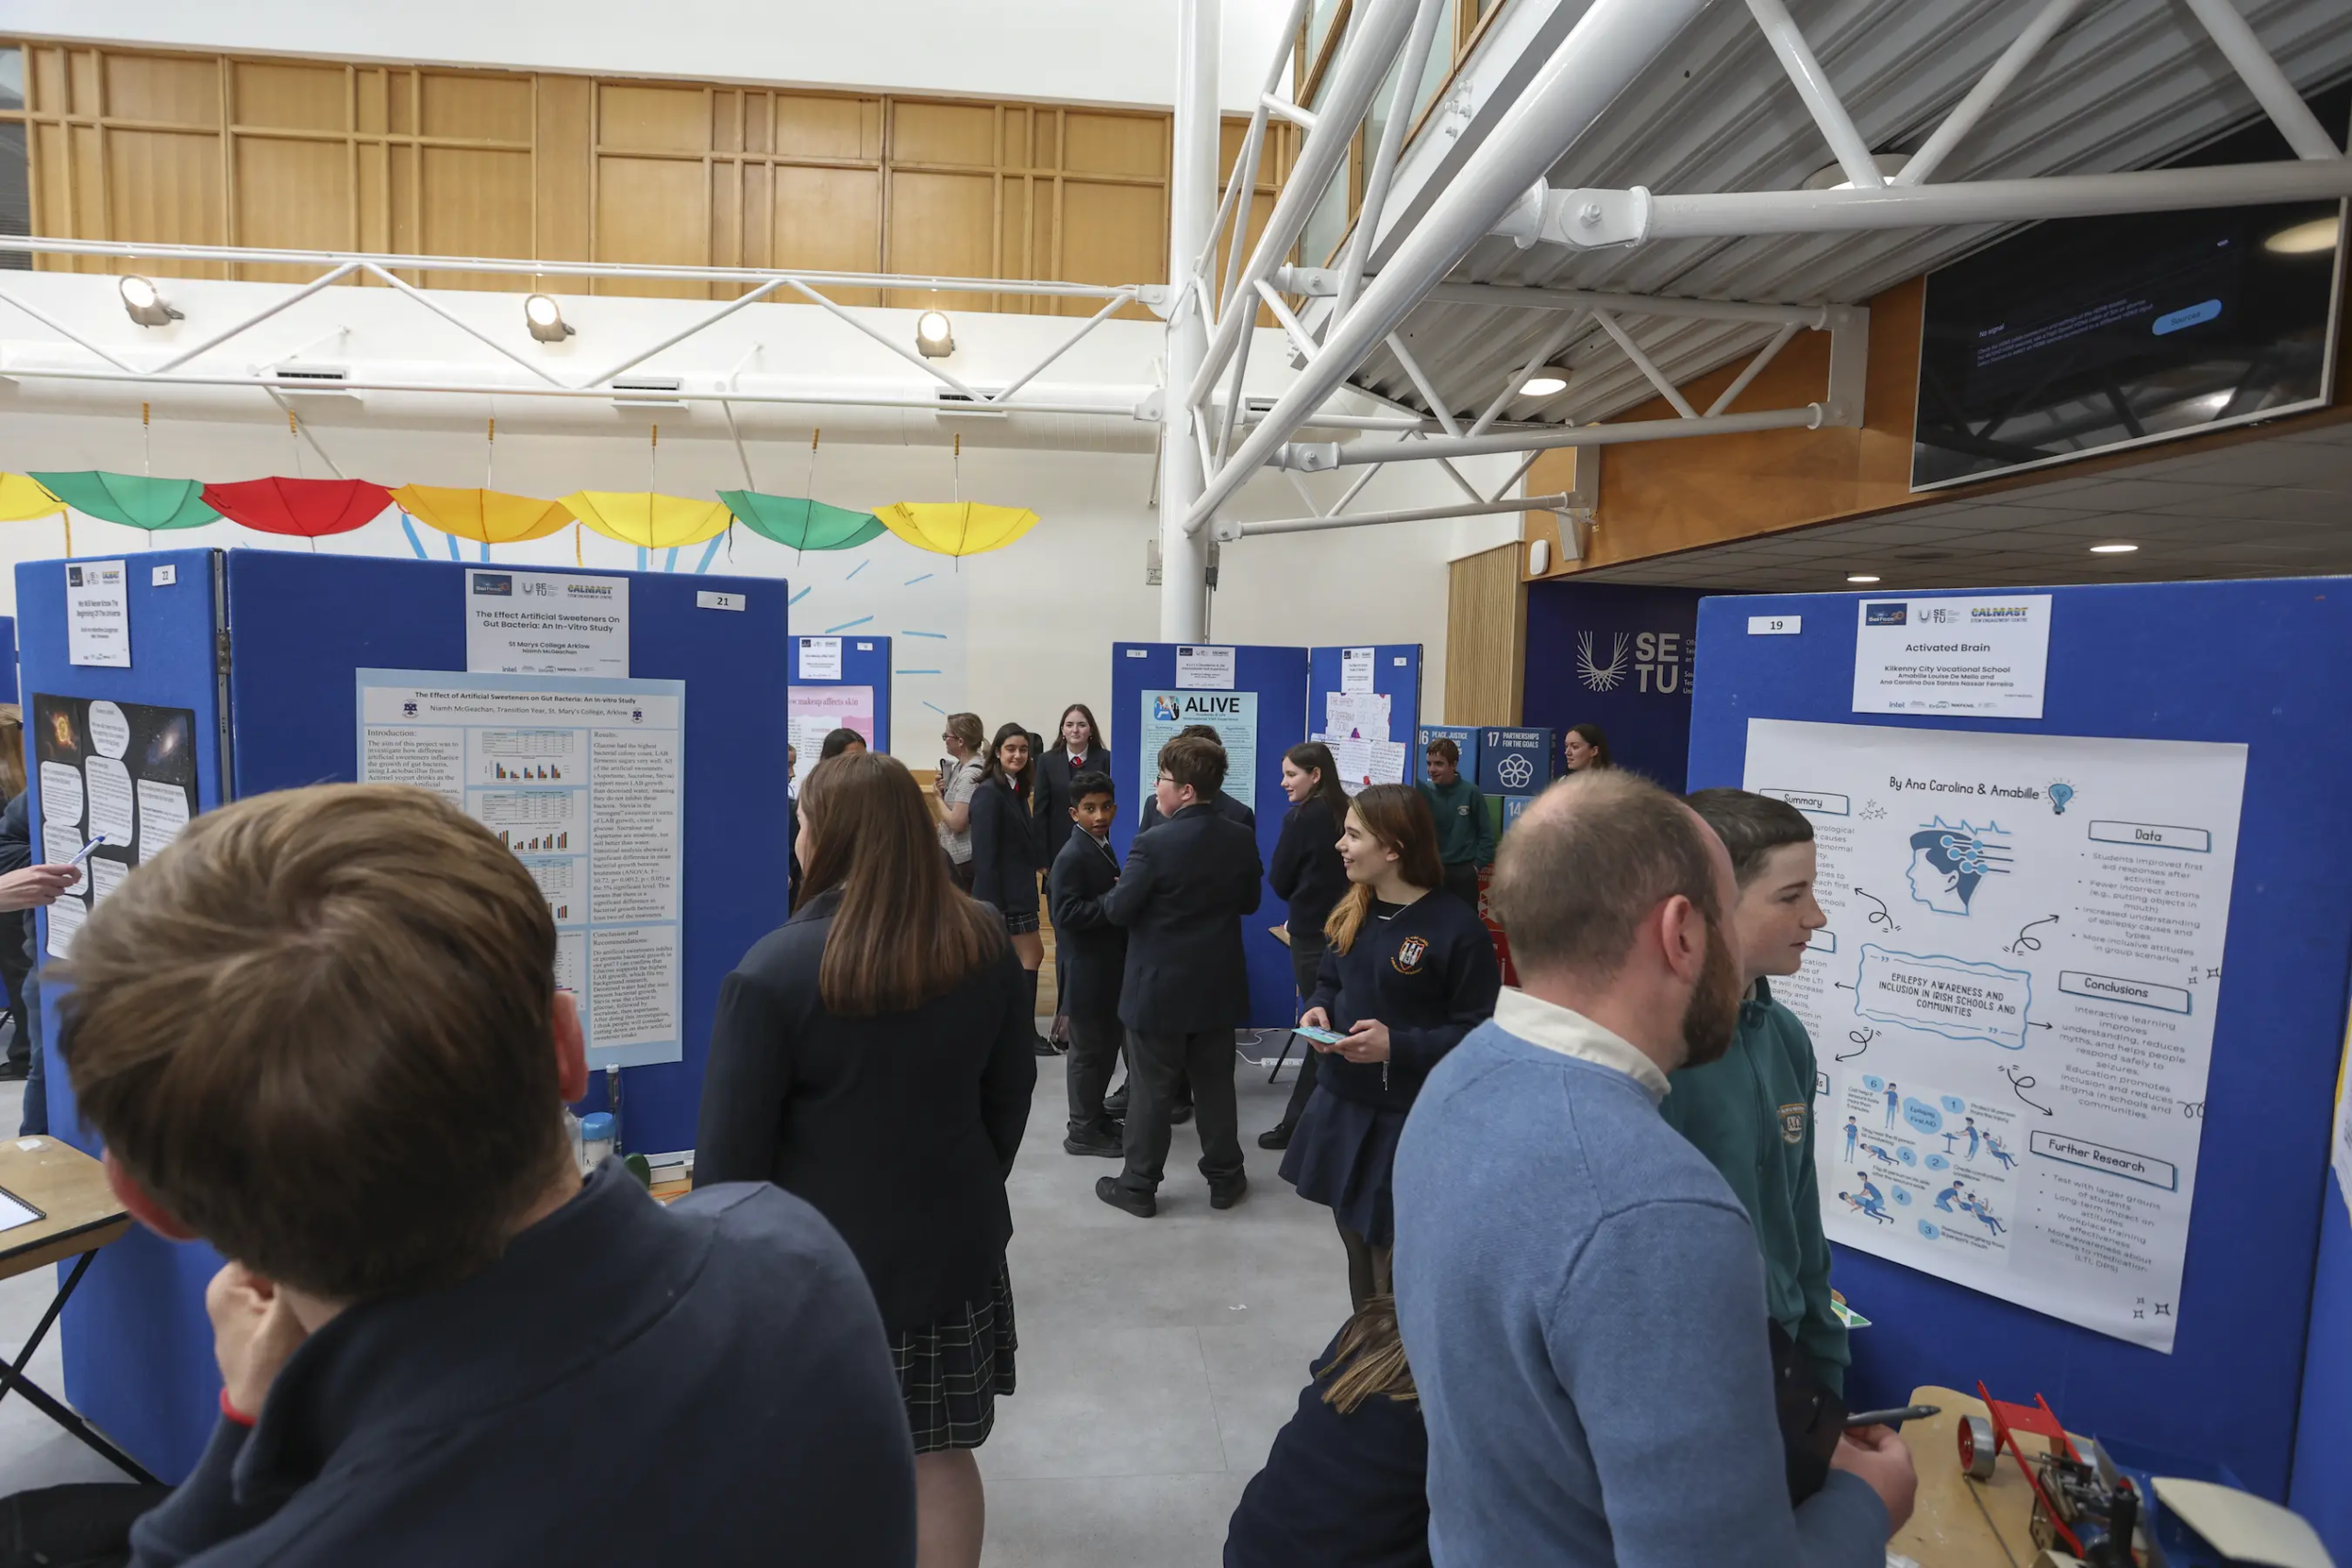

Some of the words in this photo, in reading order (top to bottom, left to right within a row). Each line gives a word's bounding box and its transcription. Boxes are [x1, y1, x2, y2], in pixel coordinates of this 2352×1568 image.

[2171, 310, 2201, 326] Sources
[1979, 330, 1987, 338] No
[1987, 323, 2005, 334] signal
[162, 571, 169, 581] 22
[568, 584, 613, 594] CALMAST
[718, 597, 729, 605] 21
[521, 613, 556, 621] Artificial
[559, 614, 606, 623] Sweeteners
[1971, 607, 2029, 616] CALMAST
[590, 625, 613, 633] Study
[1770, 621, 1783, 630] 19
[1635, 632, 1680, 661] SE
[1905, 643, 1958, 652] Activated
[1961, 643, 1990, 652] Brain
[1884, 665, 1917, 673] Kilkenny
[1634, 664, 1678, 694] TU
[798, 697, 821, 706] makeup
[845, 697, 859, 705] skin
[1185, 696, 1240, 713] ALIVE
[1448, 731, 1468, 739] JUSTICE
[1487, 731, 1499, 747] 17
[1890, 776, 1902, 791] By
[1905, 778, 1926, 790] Ana
[1929, 780, 1973, 795] Carolina
[1977, 784, 1986, 795] &
[1990, 784, 2040, 800] Amabille
[1784, 794, 1823, 808] Summary
[1509, 802, 1521, 817] 14
[2135, 829, 2162, 841] Data
[2093, 852, 2133, 863] Students
[2136, 857, 2181, 868] improved
[2185, 862, 2203, 871] first
[2119, 865, 2165, 875] responses
[2124, 875, 2165, 886] activities
[1892, 973, 1928, 987] EPILEPSY
[1931, 980, 1983, 998] AWARENESS
[1985, 991, 2004, 1001] AND
[2085, 977, 2149, 998] Conclusions
[1879, 981, 1919, 996] INCLUSION
[1922, 989, 1929, 998] IN
[1932, 991, 1953, 1002] IRISH
[1955, 997, 1994, 1010] SCHOOLS
[1997, 1006, 2016, 1015] AND
[1917, 999, 1972, 1018] COMMUNITIES
[2075, 1006, 2129, 1021] Interactive
[2132, 1016, 2177, 1031] learning
[2099, 1021, 2147, 1035] improves
[2075, 1047, 2118, 1061] respond
[2120, 1055, 2150, 1068] safely
[2154, 1062, 2164, 1070] to
[1871, 1079, 1877, 1088] 6
[2065, 1065, 2116, 1080] Education
[2120, 1076, 2171, 1093] promotes
[1903, 1152, 1910, 1160] 5
[2049, 1138, 2090, 1158] Further
[2093, 1150, 2145, 1173] Research
[1931, 1158, 1939, 1168] 2
[1897, 1191, 1904, 1201] 4
[2052, 1174, 2071, 1185] Test
[2074, 1181, 2094, 1191] with
[2097, 1186, 2124, 1200] larger
[2126, 1195, 2161, 1210] groups
[1925, 1225, 1932, 1235] 3
[2057, 1212, 2107, 1232] Workplace
[2109, 1228, 2146, 1245] training
